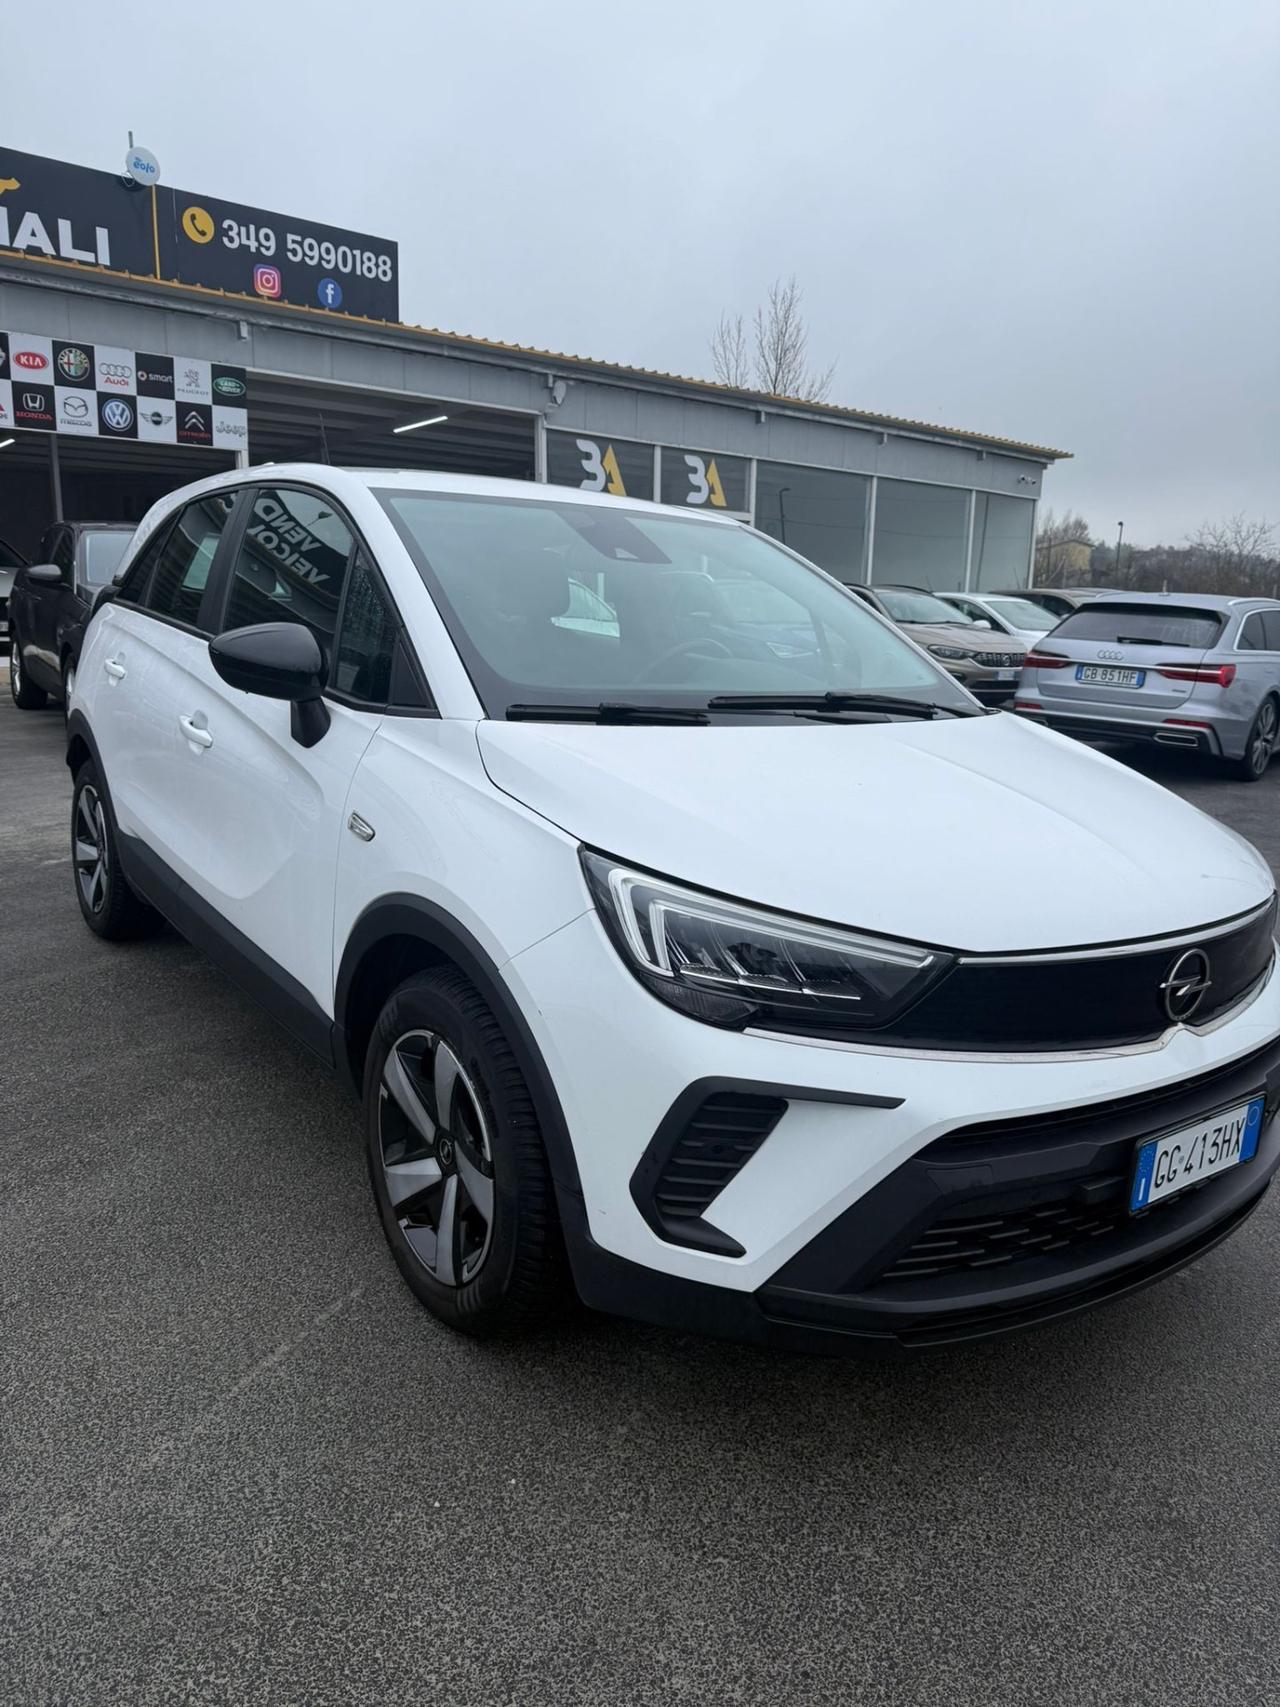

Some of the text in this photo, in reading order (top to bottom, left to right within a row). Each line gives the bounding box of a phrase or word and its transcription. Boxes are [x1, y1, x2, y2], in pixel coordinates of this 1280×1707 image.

[222, 219, 393, 282] 349 5990188
[20, 355, 42, 367] KIA
[149, 373, 173, 384] smart
[16, 411, 53, 420] HONDA
[1084, 668, 1136, 683] GB 851HF
[1154, 1117, 1246, 1188] GG 413HX
